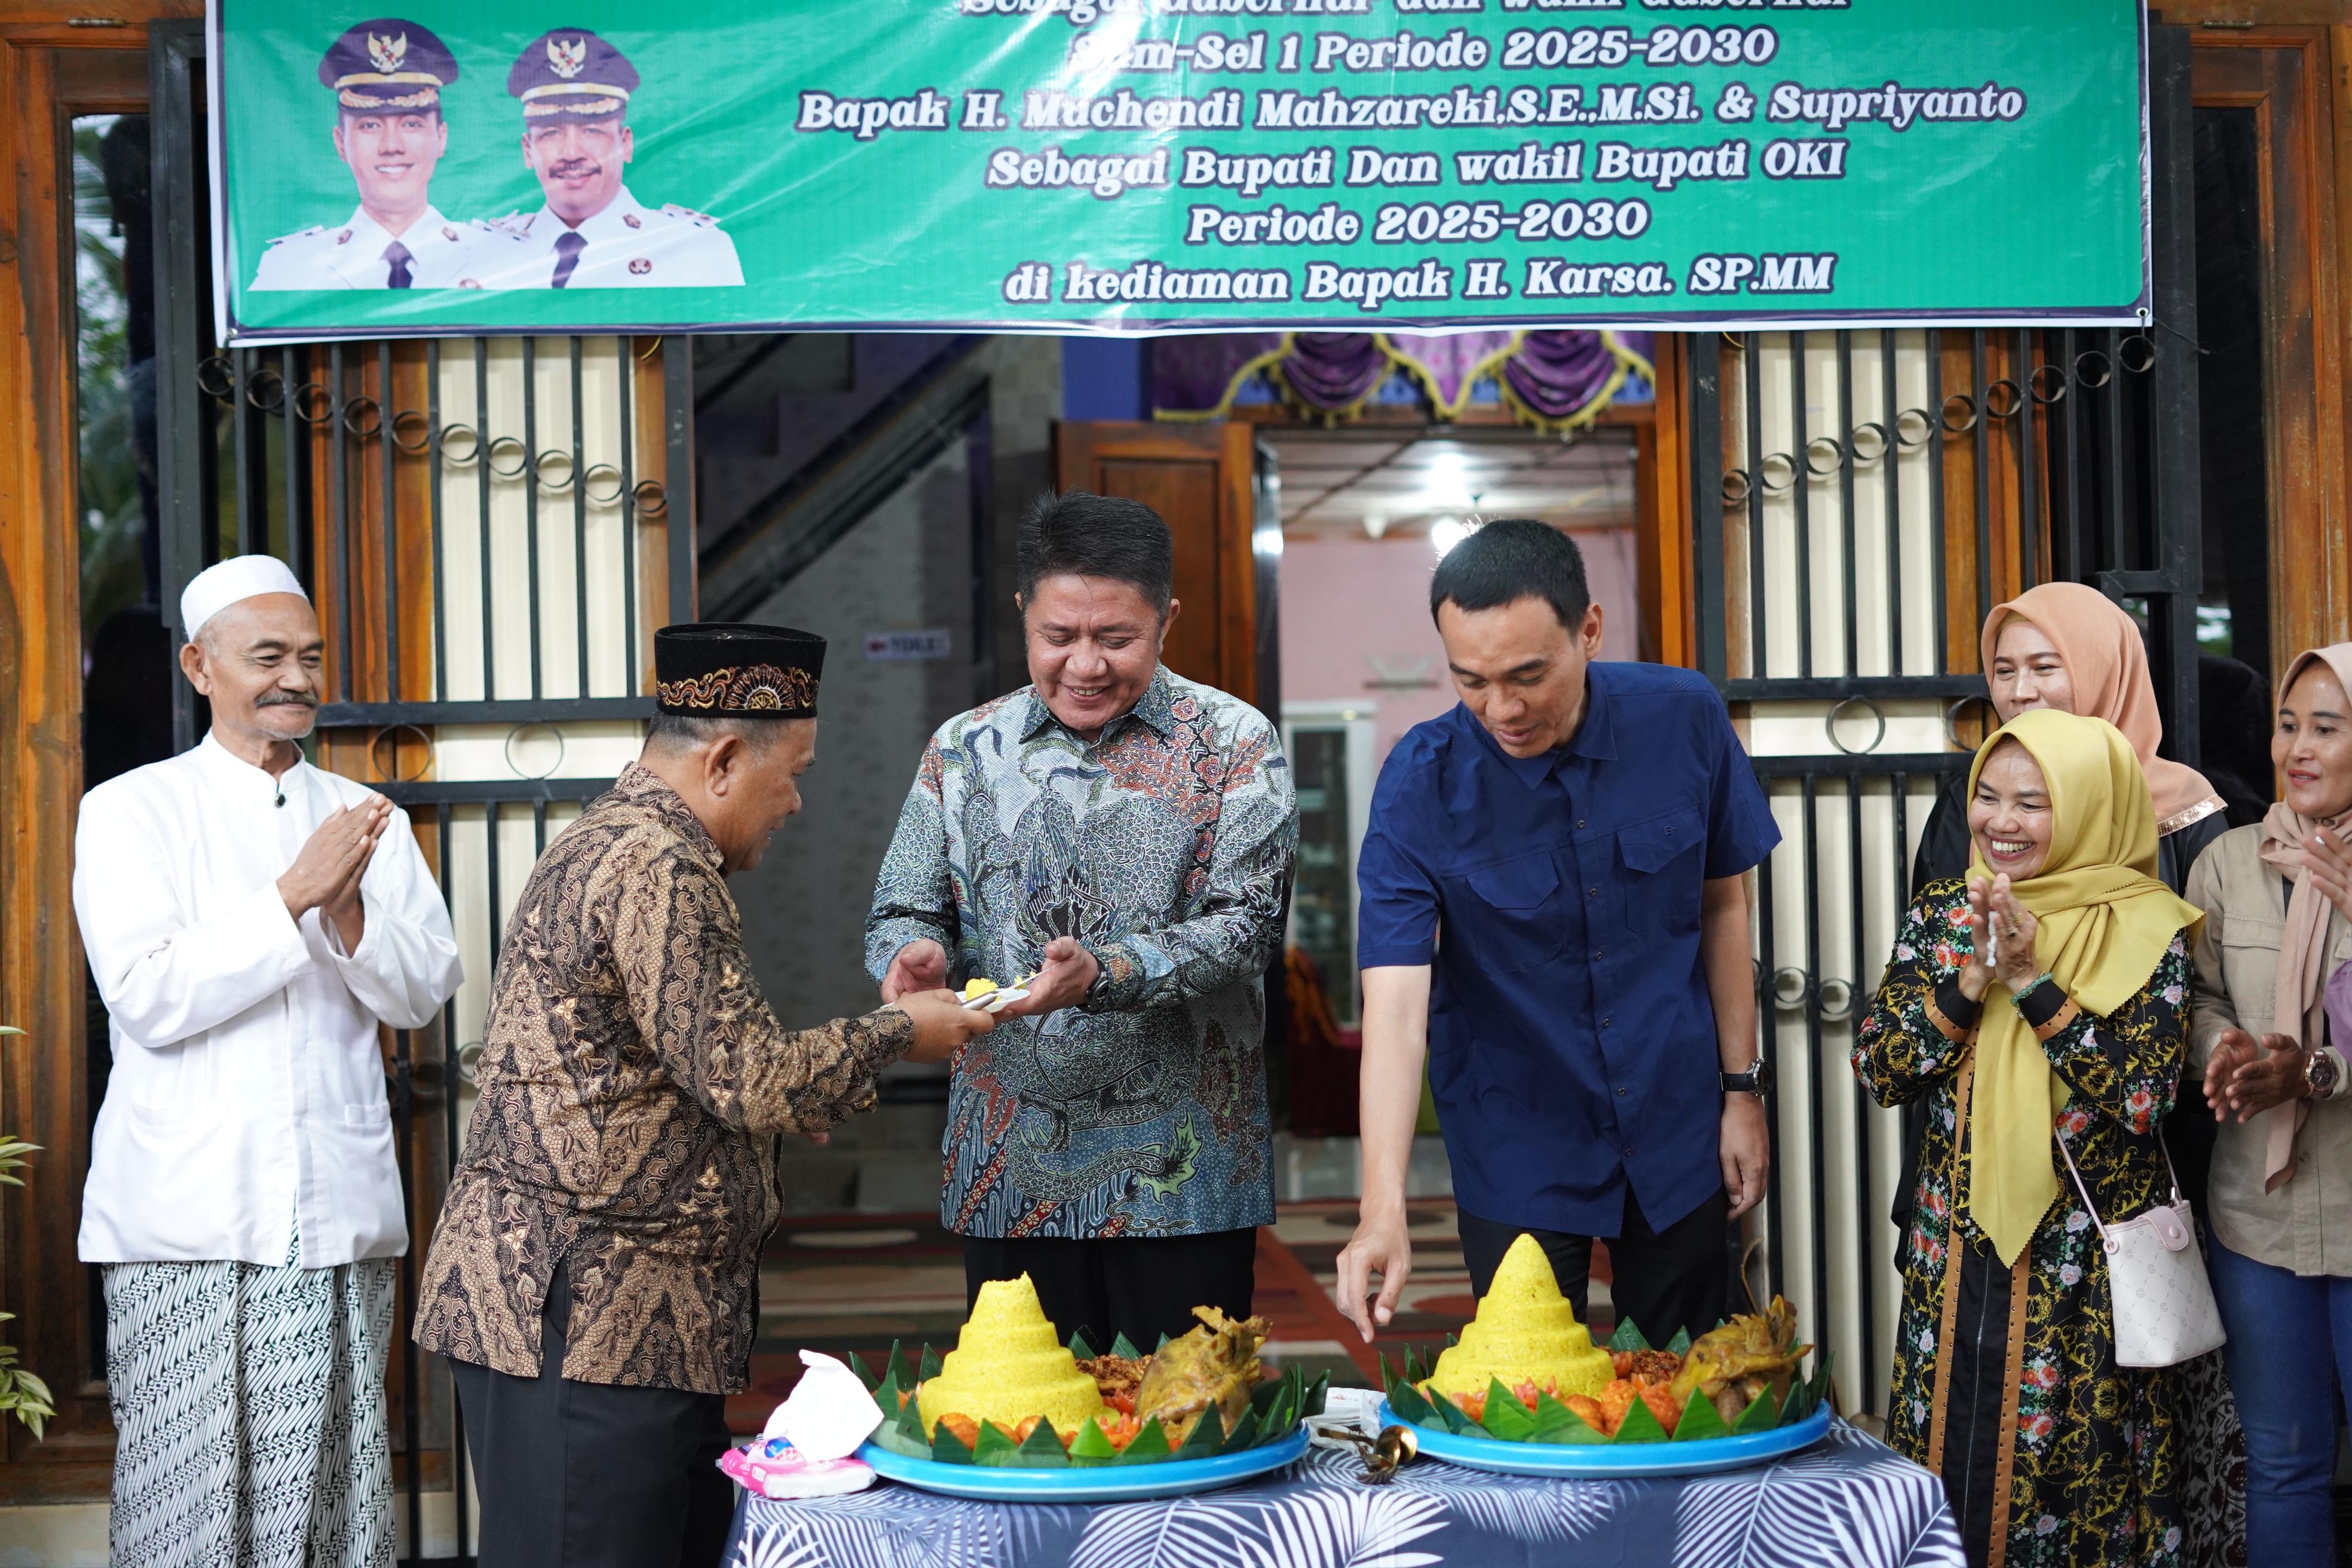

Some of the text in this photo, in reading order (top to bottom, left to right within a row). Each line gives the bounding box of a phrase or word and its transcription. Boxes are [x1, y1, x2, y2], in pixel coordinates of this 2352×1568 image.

[1070, 29, 1774, 70] Sm-Sel 1 Periode 2025-2030
[799, 91, 947, 137] Bapak
[963, 93, 1006, 127] H.
[1024, 90, 1239, 127] Muchendi
[1719, 86, 1753, 118] &
[1770, 85, 2022, 127] Supriyanto
[988, 142, 1845, 195] Sebagai Bupati Dan wakil Bupati OKI
[1188, 202, 1647, 241] Periode 2025-2030
[1006, 257, 1833, 308] di kediaman Bapak H. Karsa. SP.MM
